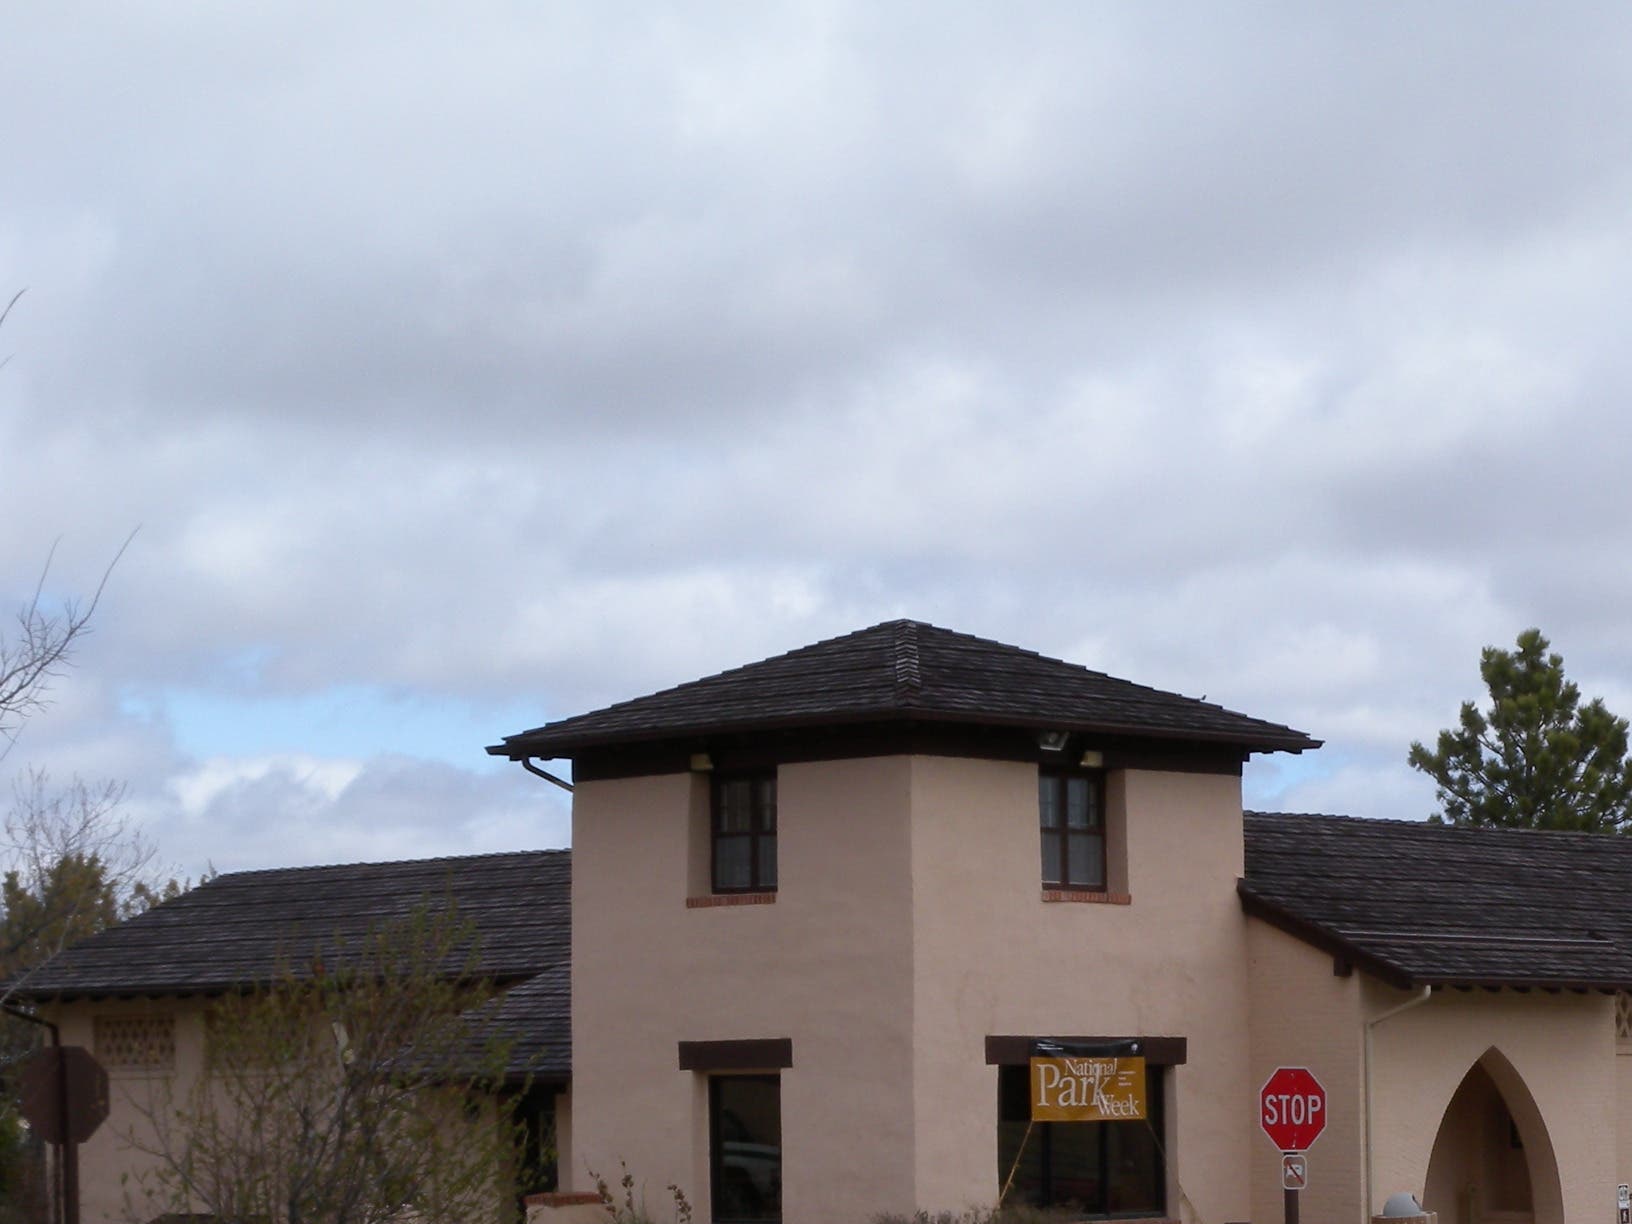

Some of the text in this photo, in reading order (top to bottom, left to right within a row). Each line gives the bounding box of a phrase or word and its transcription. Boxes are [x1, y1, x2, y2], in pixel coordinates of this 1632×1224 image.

[1064, 1058, 1118, 1077] National
[1037, 1063, 1111, 1107] Park
[1096, 1093, 1140, 1117] Week
[1265, 1094, 1322, 1125] STOP
